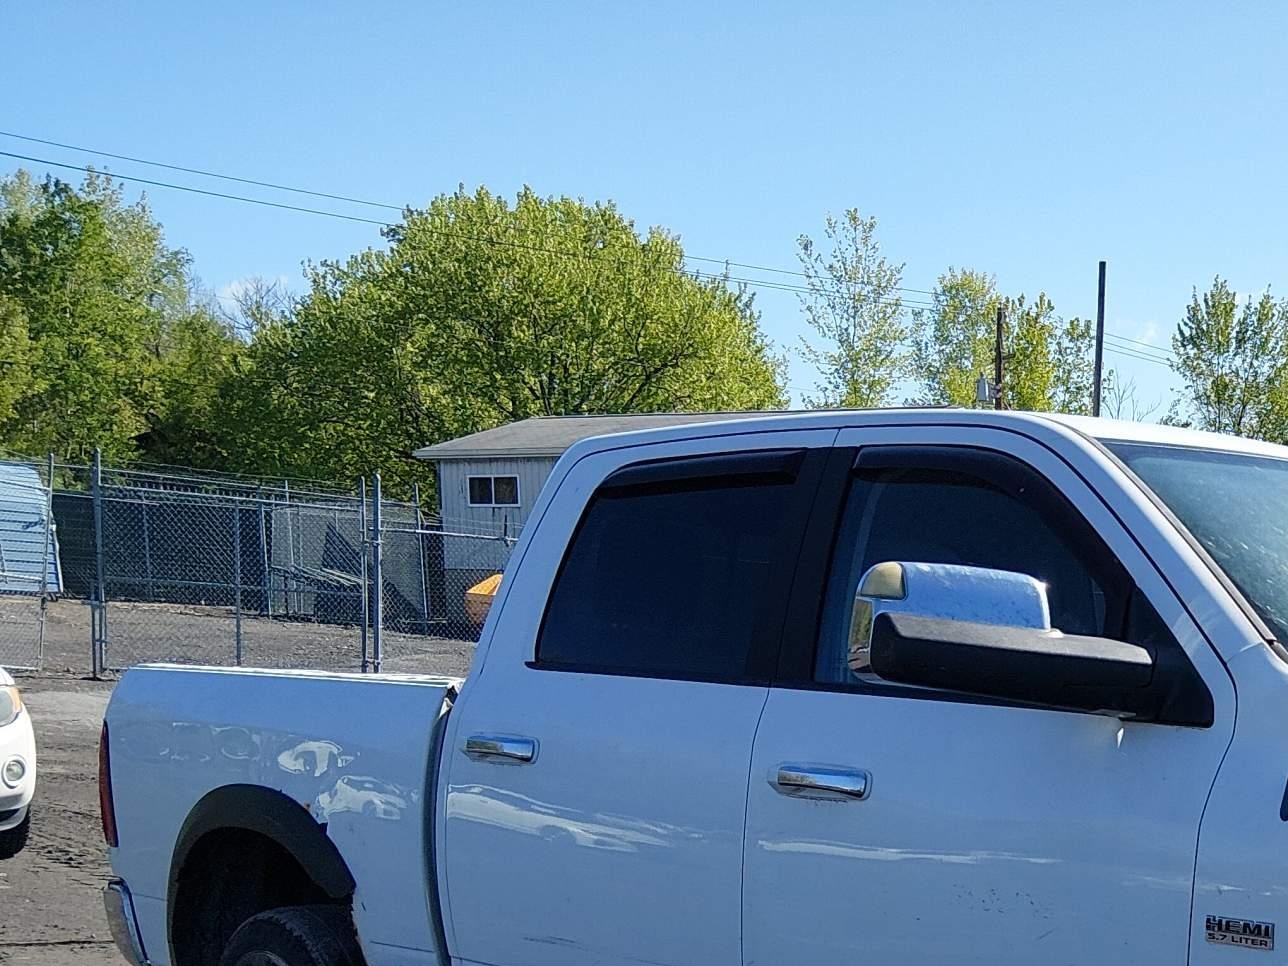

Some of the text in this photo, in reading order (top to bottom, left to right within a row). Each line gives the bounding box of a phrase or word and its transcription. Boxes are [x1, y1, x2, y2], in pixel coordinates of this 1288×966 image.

[1205, 917, 1271, 937] HEMI
[1207, 932, 1269, 948] 5.7 LITER
